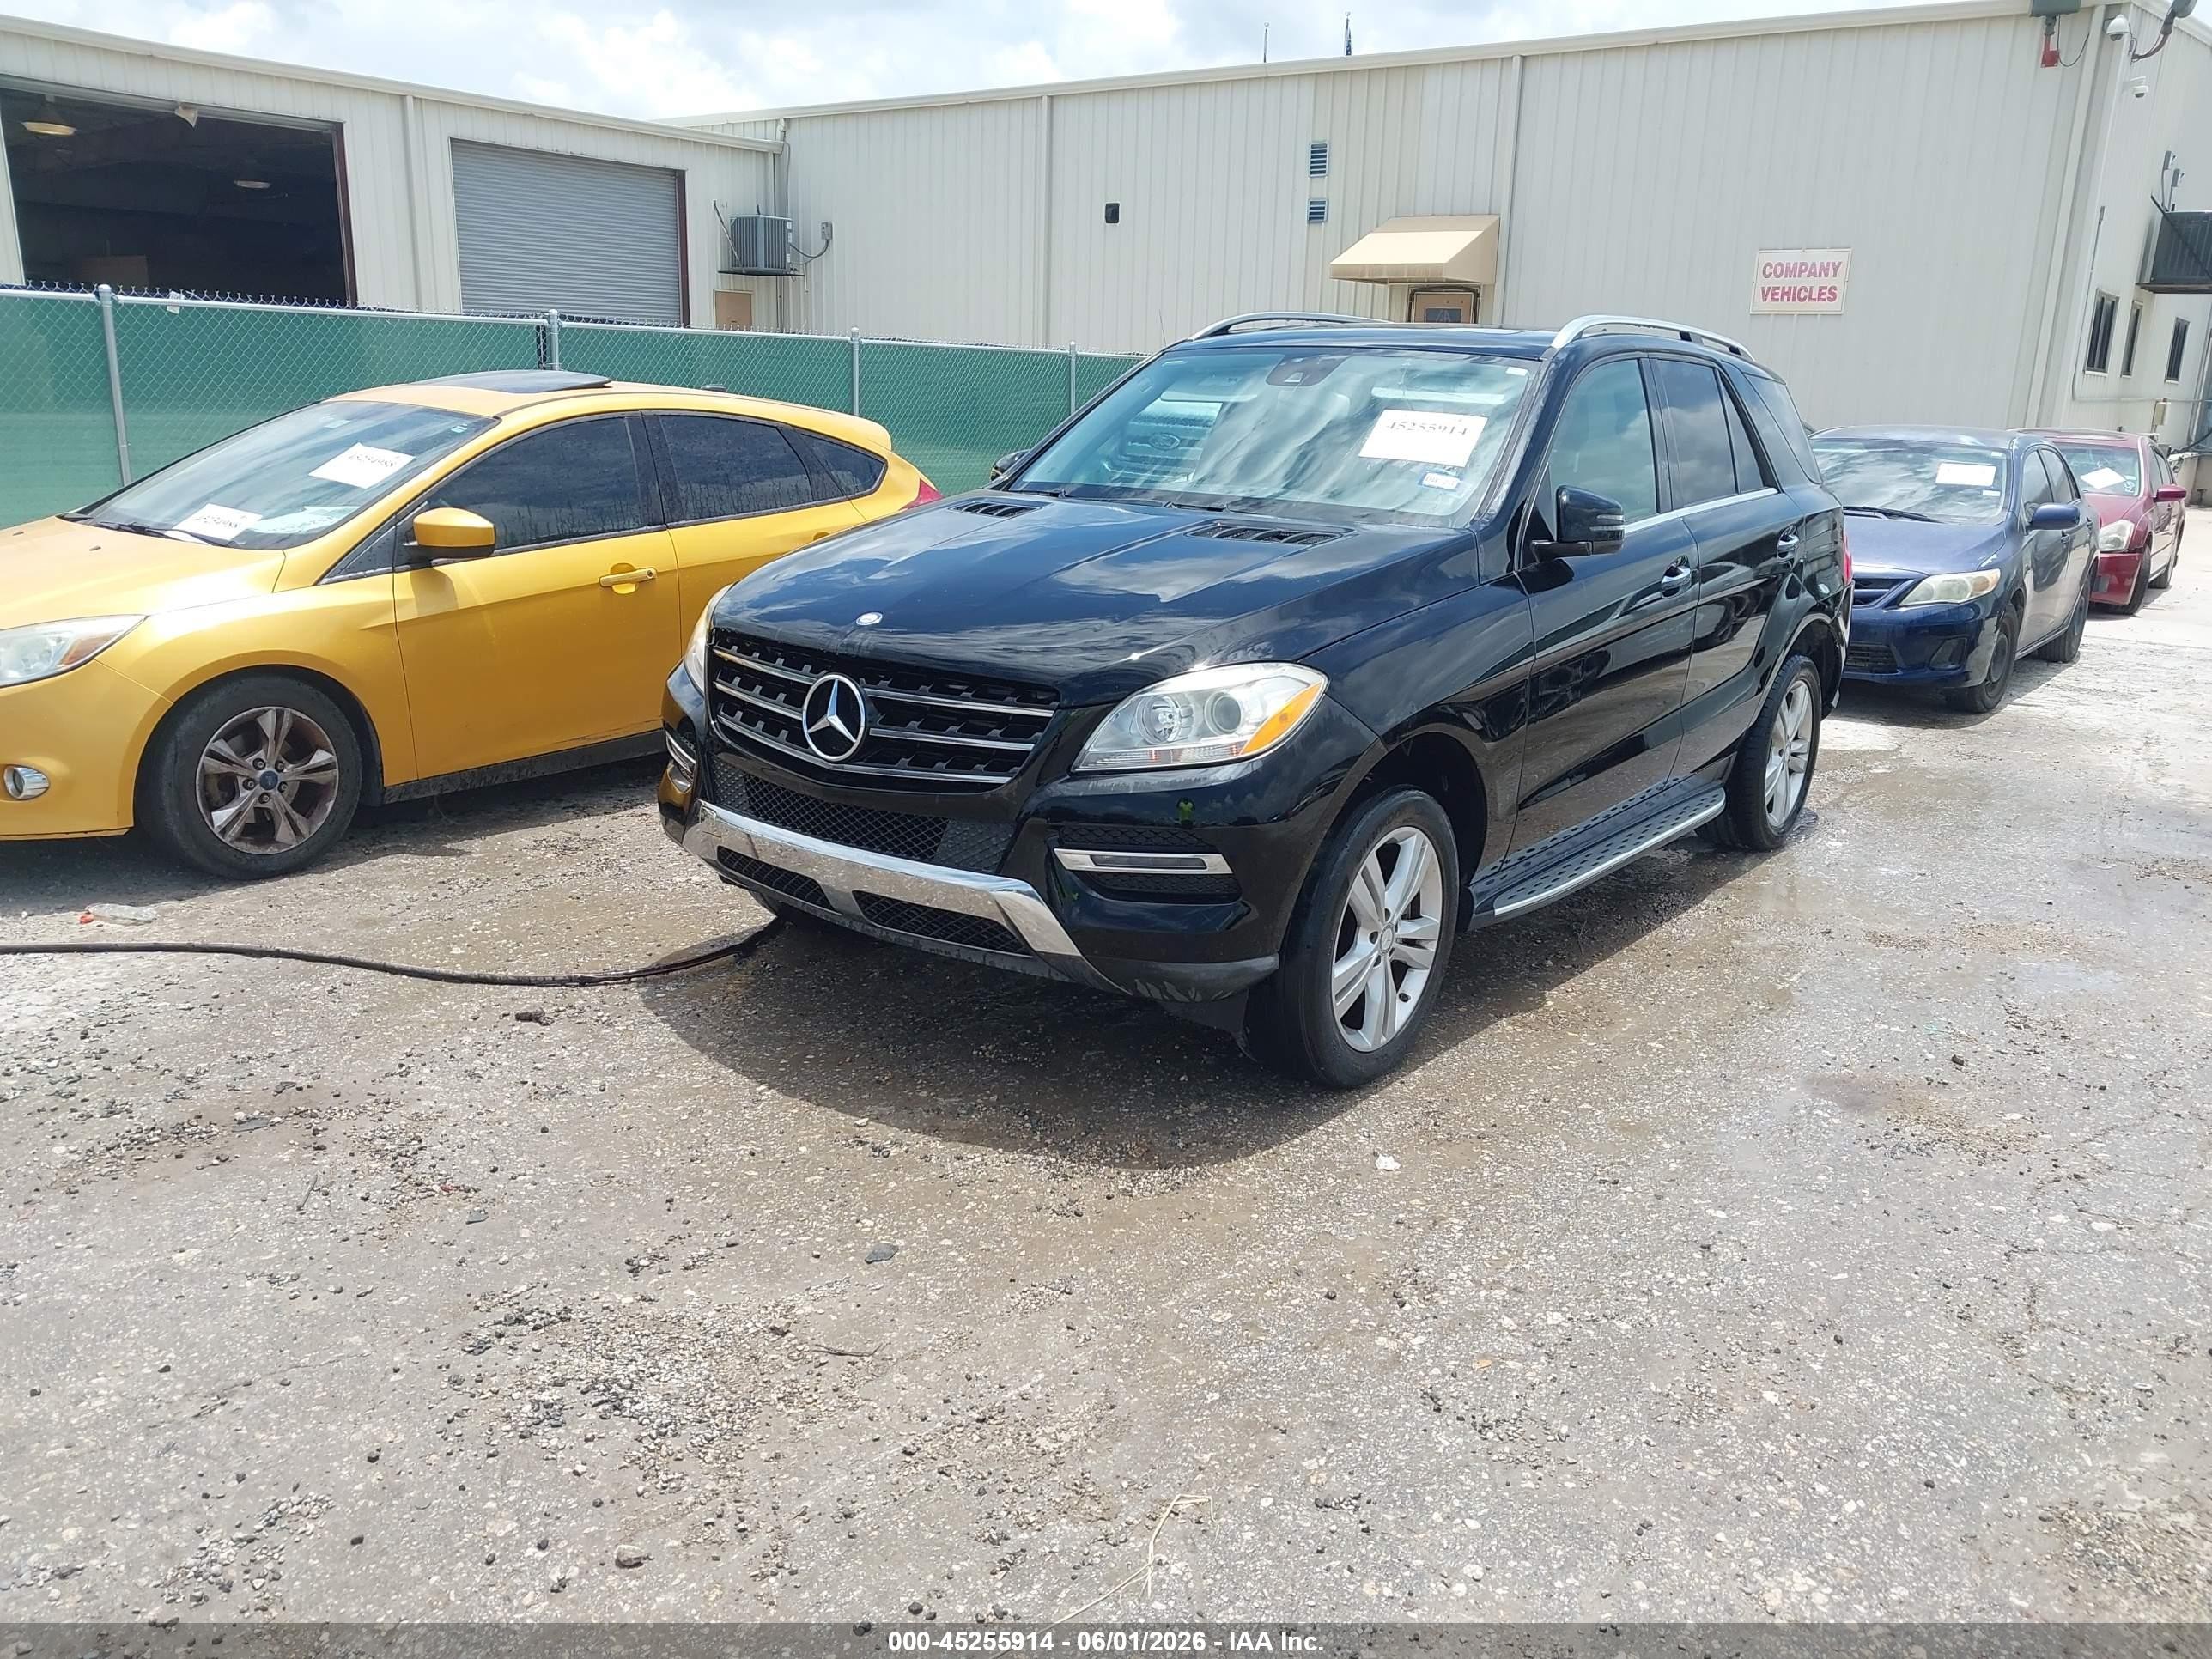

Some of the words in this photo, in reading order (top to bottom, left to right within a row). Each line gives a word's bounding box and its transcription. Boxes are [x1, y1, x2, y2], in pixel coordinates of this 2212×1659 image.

[1762, 261, 1842, 279] COMPANY
[1760, 285, 1838, 303] VEHICLES
[1386, 421, 1468, 436] 45255914
